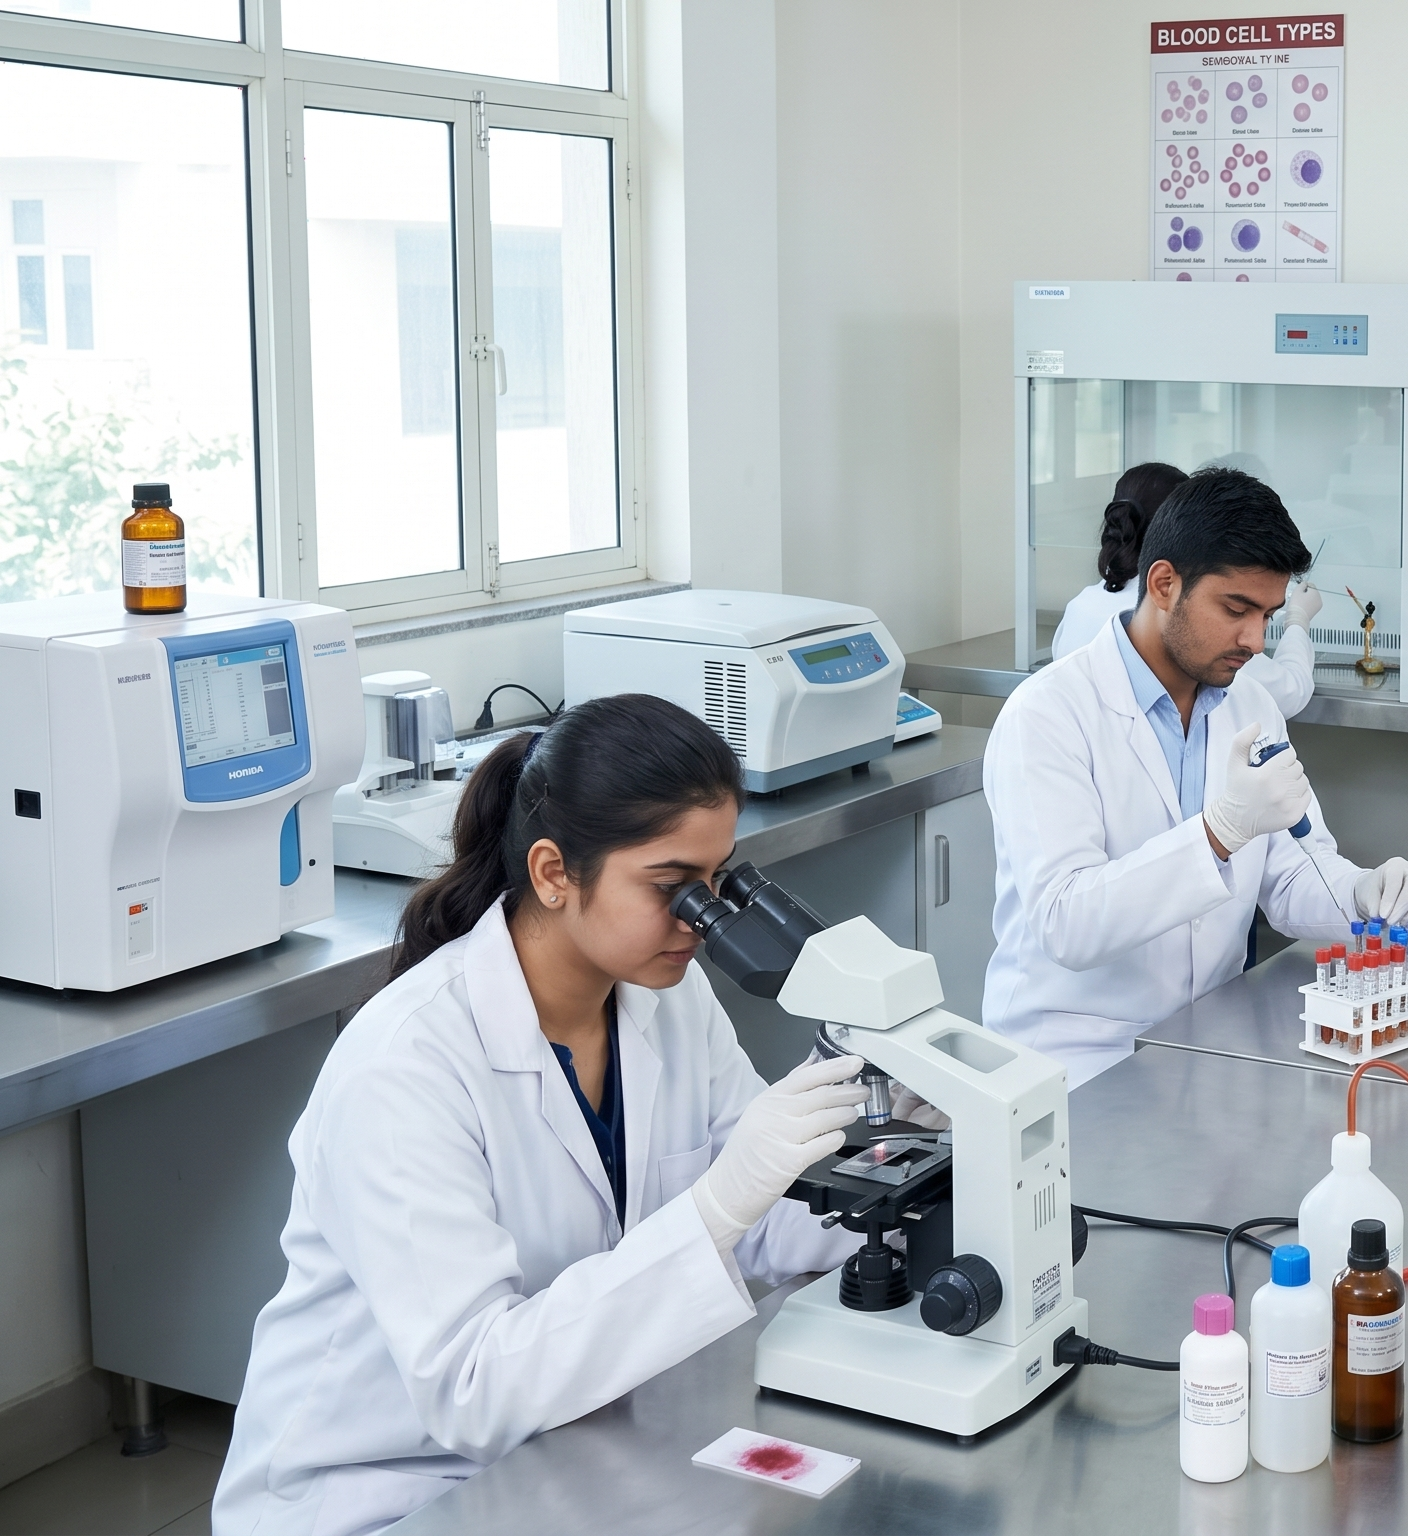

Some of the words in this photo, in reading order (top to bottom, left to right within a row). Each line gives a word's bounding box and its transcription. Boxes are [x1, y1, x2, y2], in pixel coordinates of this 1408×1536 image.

[1158, 27, 1220, 46] BLOOD
[1225, 25, 1272, 43] CELL
[1276, 22, 1336, 42] TYPES
